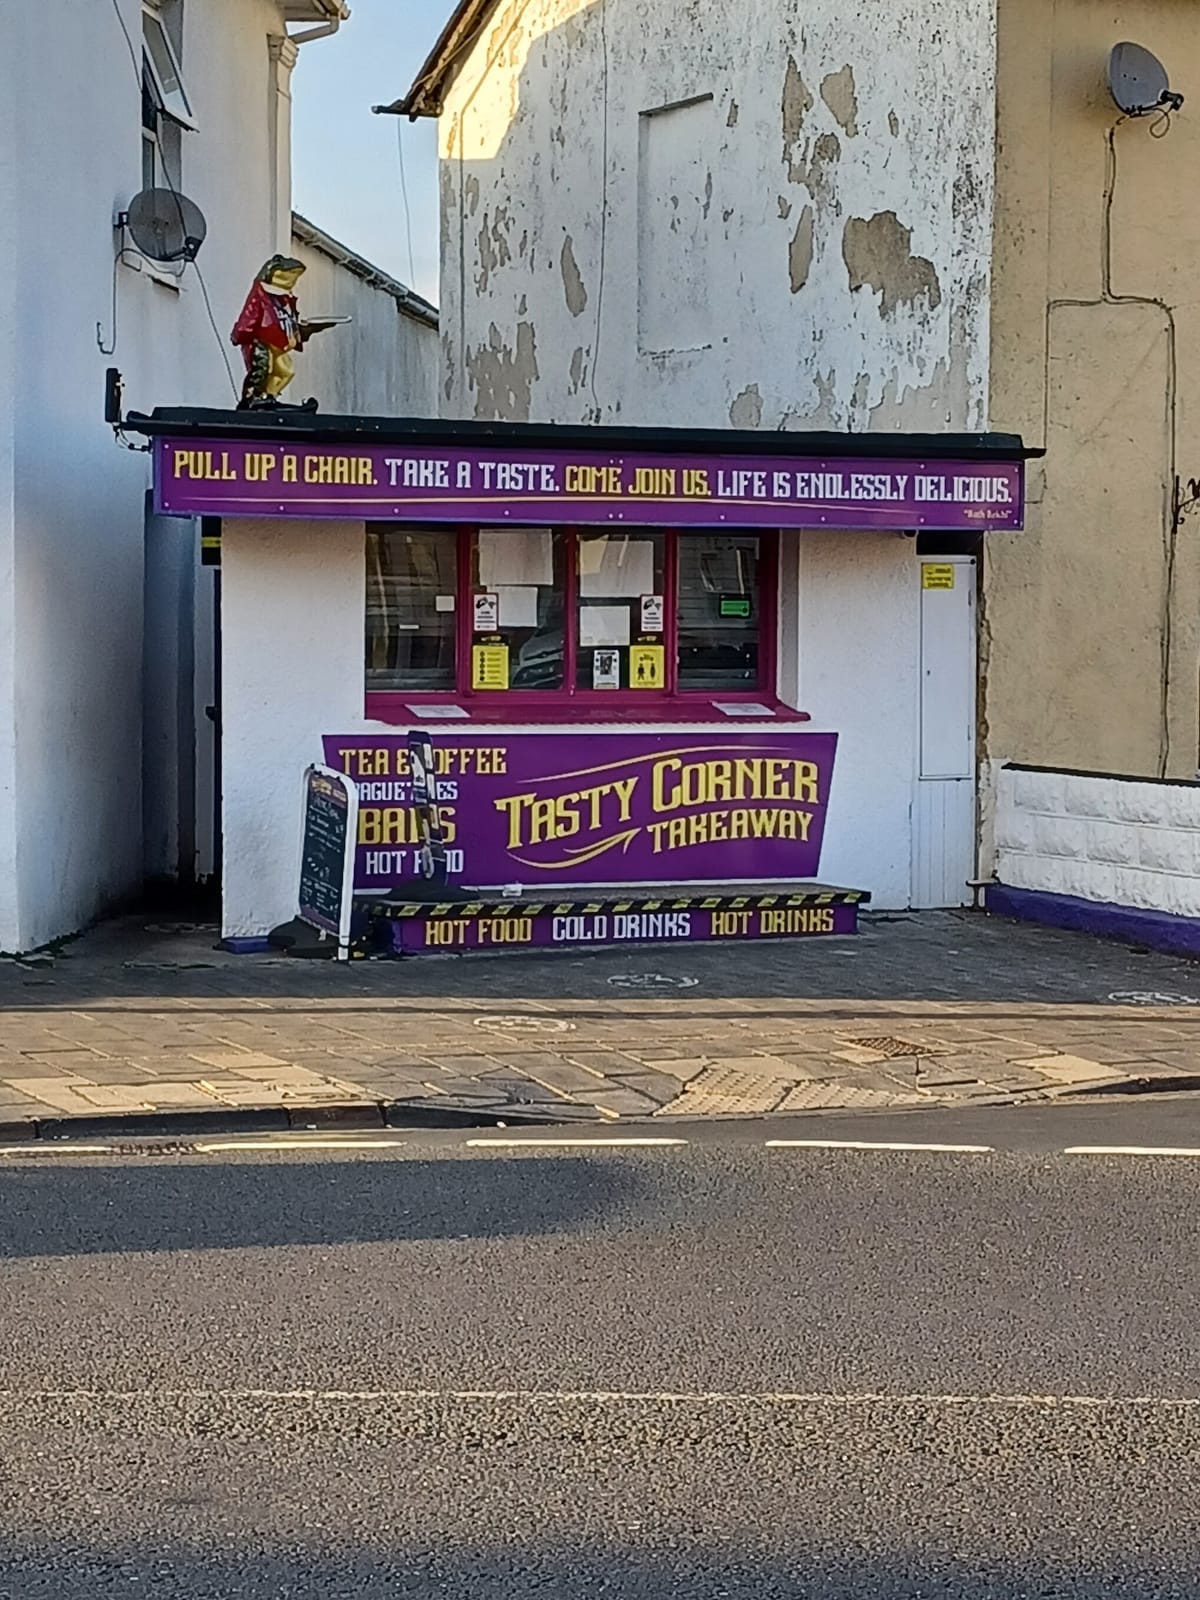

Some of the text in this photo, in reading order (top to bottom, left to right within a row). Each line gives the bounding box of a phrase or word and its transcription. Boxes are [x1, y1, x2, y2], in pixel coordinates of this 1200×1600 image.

[174, 450, 1013, 503] PULL UP A CHAIR. TAKE A TASTE. COME JOIN US. LIFE IS ENDLESSLY DELICIOUS.
[338, 748, 507, 776] TEA & OFFEE
[354, 781, 459, 801] AGUEES
[493, 757, 820, 850] TASTY CORNER
[357, 806, 457, 845] BAS
[646, 807, 816, 855] TAKEAWAY
[365, 849, 465, 875] HOT FD
[425, 908, 835, 946] HOT FOOD COLD DRINKS HOT DRINKS
